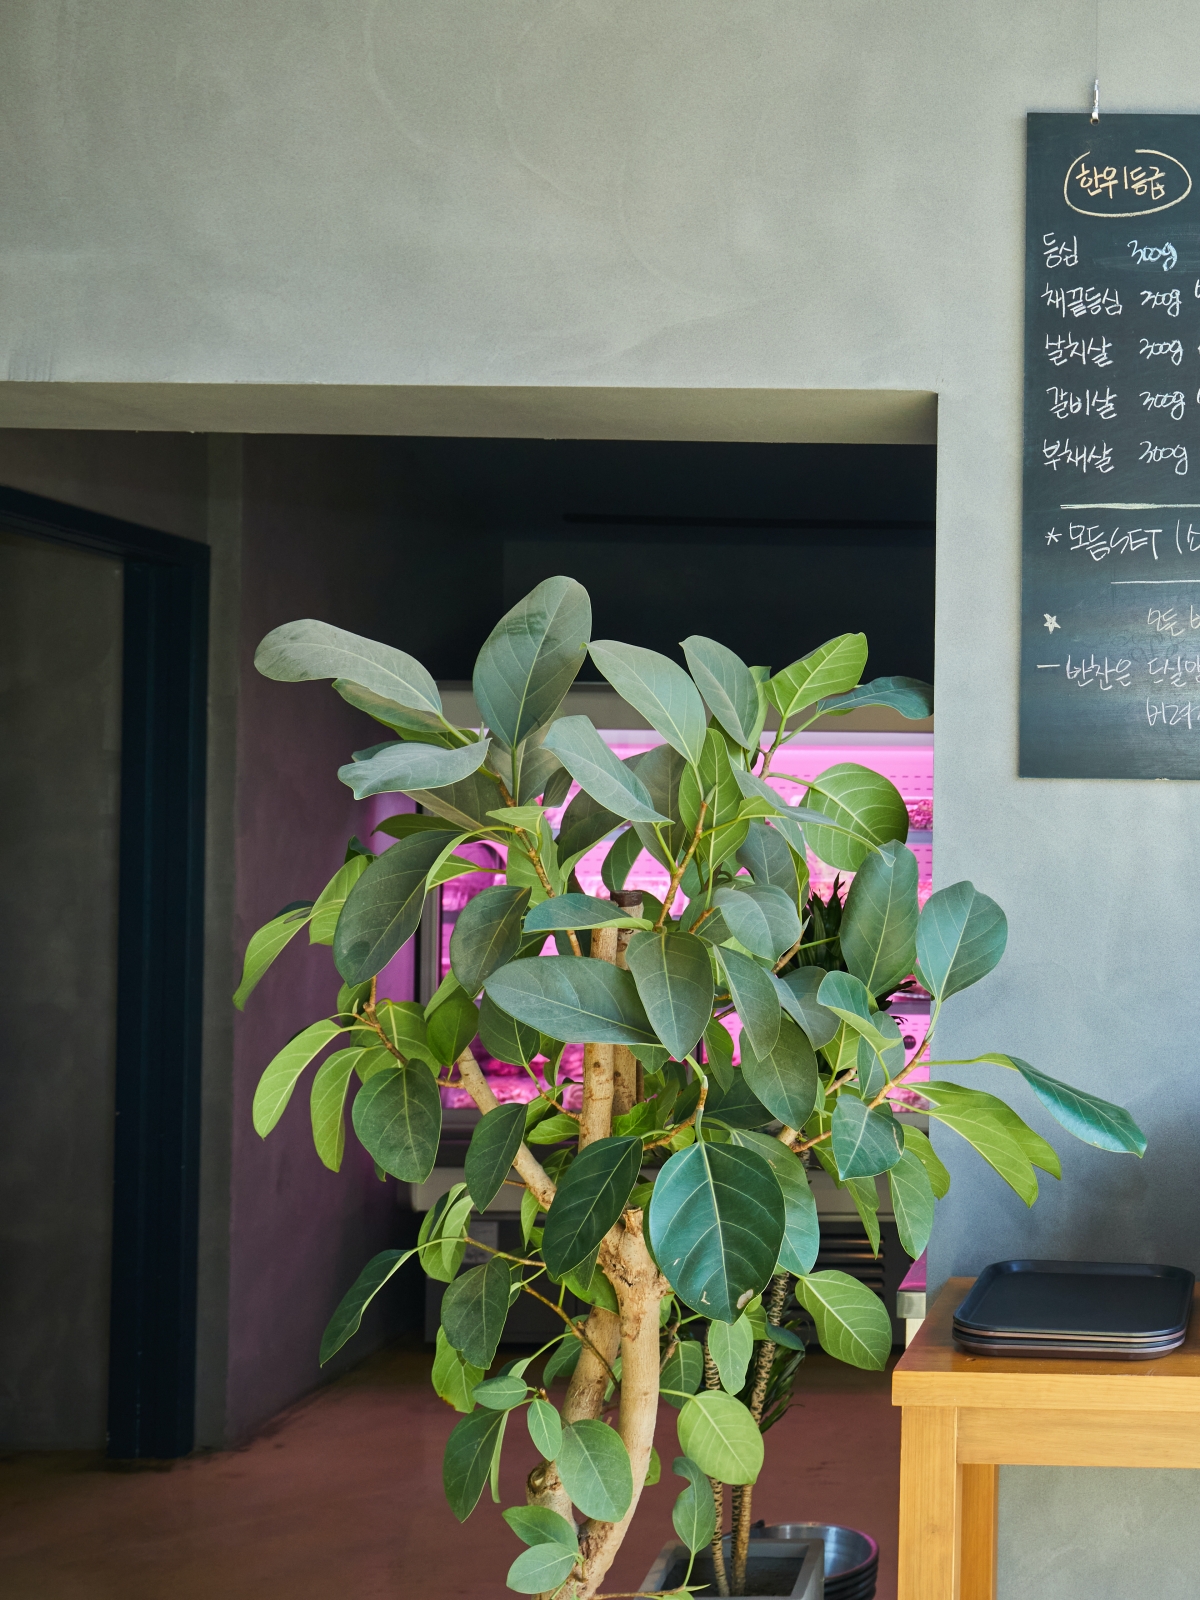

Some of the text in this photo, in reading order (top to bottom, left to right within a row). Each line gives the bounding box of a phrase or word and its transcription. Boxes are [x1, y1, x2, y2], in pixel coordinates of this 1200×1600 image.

[1043, 232, 1079, 269] 등심
[1127, 240, 1178, 271] 300g
[1140, 288, 1182, 317] 300g
[1139, 339, 1184, 366] 300g
[1046, 385, 1118, 420] 갈비살
[1139, 391, 1186, 420] 300g
[1043, 439, 1115, 474] 부채살
[1139, 440, 1188, 476] 300g
[1147, 607, 1185, 637] 모든
[1066, 654, 1132, 691] 반찬은
